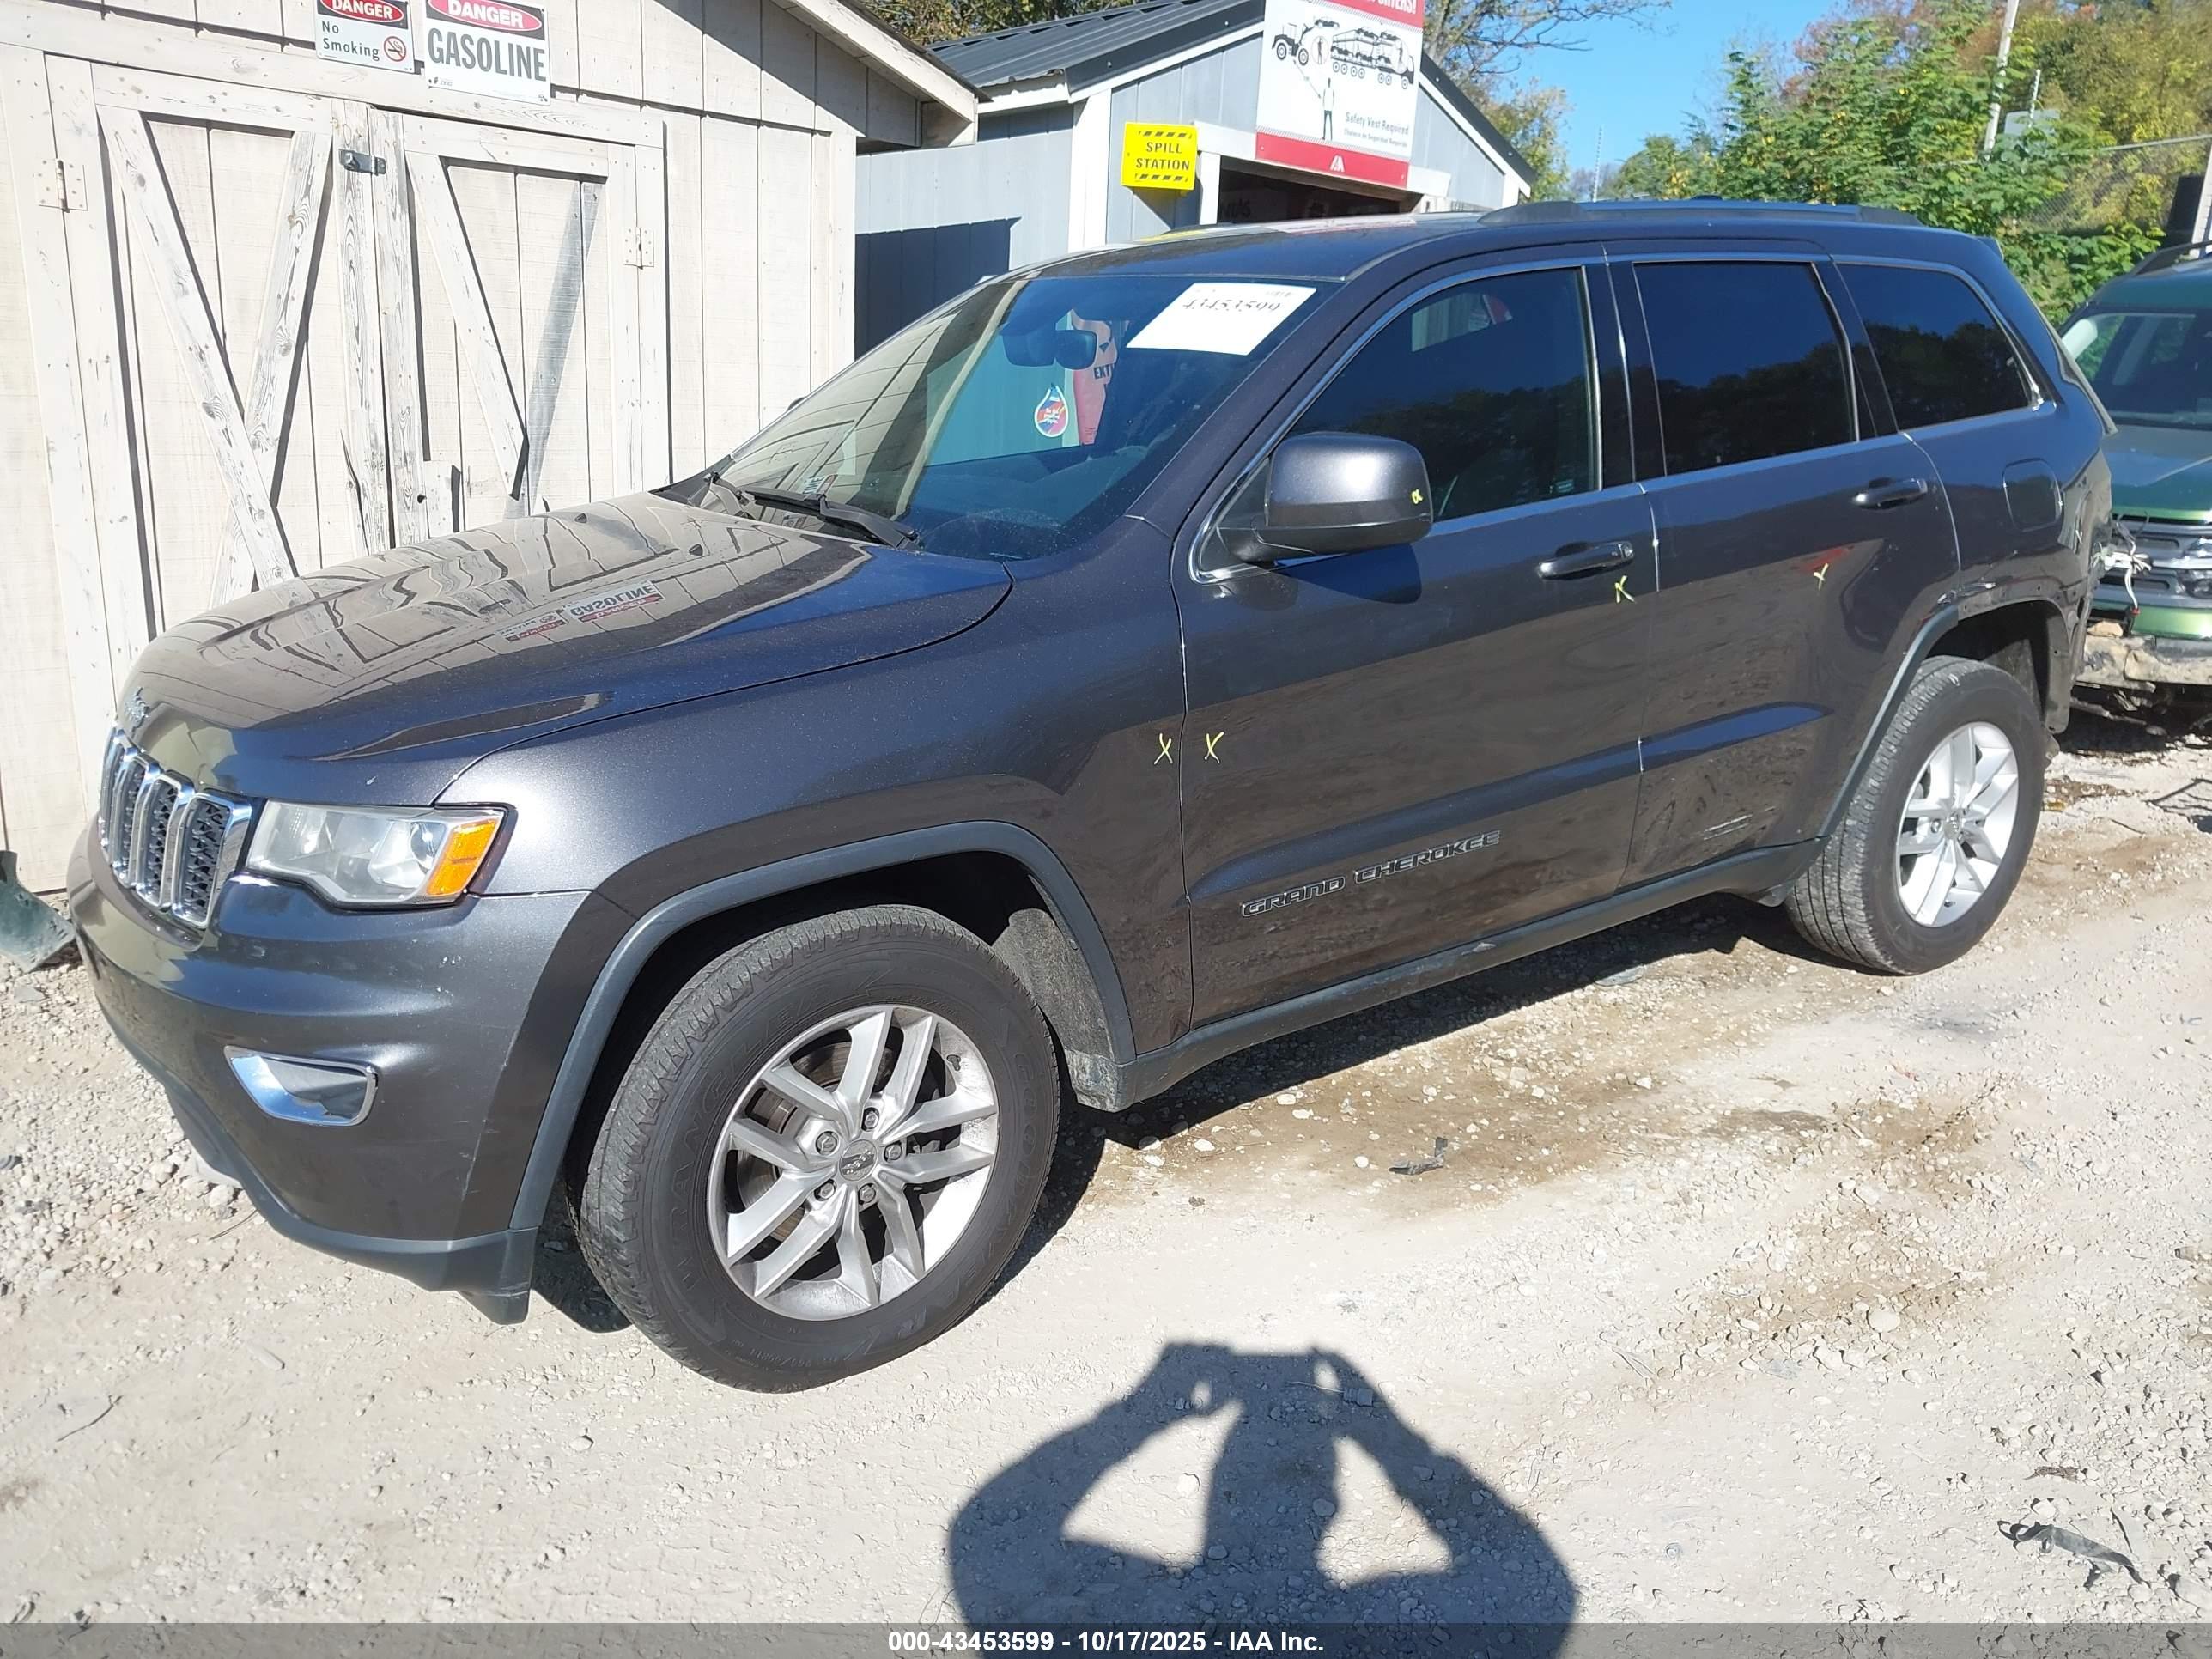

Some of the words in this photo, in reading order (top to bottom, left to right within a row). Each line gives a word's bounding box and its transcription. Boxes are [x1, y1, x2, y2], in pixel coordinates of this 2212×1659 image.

[332, 0, 393, 20] DANGER
[448, 0, 524, 28] DANGER
[322, 20, 339, 33] No
[323, 37, 380, 62] Smoking
[428, 27, 547, 82] GASOLINE
[1146, 142, 1182, 154] SPILL
[1136, 157, 1190, 171] STATION
[1242, 876, 1346, 917] GRAND
[1353, 830, 1501, 884] CHEROKEE
